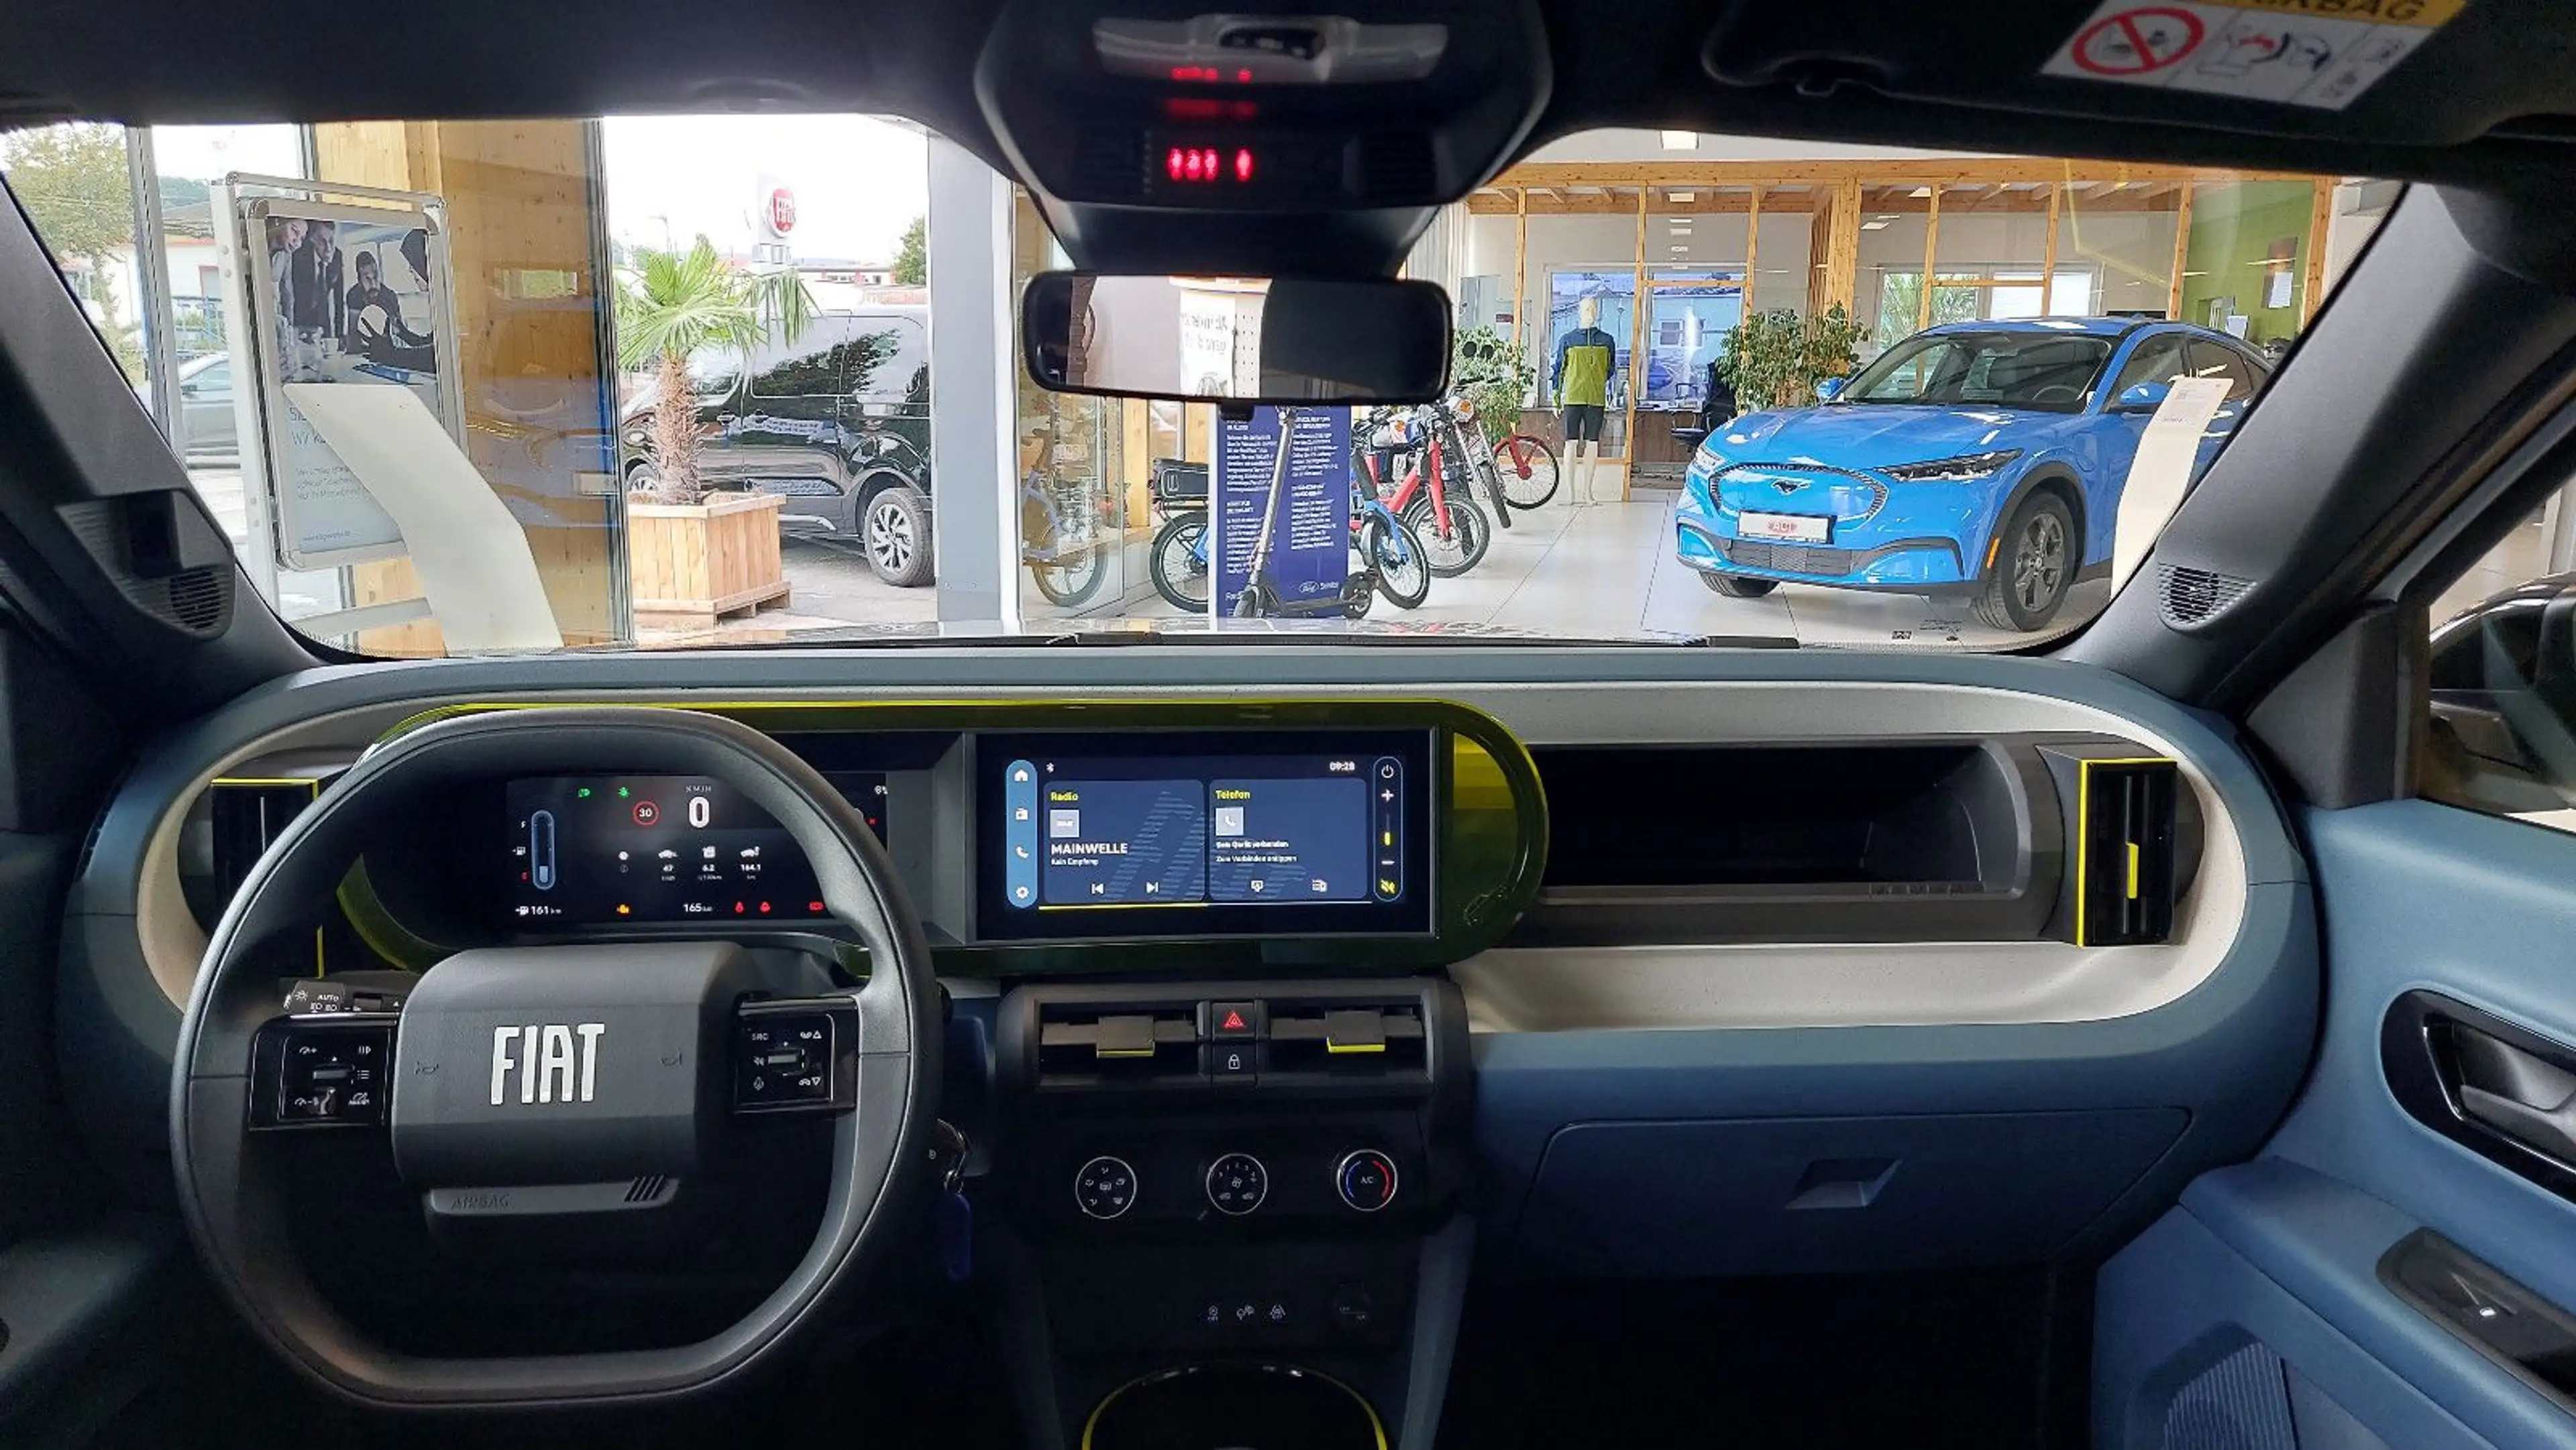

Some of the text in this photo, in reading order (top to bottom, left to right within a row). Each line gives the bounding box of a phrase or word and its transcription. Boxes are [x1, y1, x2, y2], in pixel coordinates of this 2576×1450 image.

[1051, 791, 1079, 801] Radio
[1216, 790, 1250, 799] Telefon
[639, 807, 653, 818] 30
[689, 796, 710, 828] 0
[1051, 843, 1128, 855] MAINWELLE
[531, 906, 549, 915] 161
[683, 903, 702, 912] 165
[317, 993, 339, 1001] AUTO
[490, 1023, 605, 1105] FIAT
